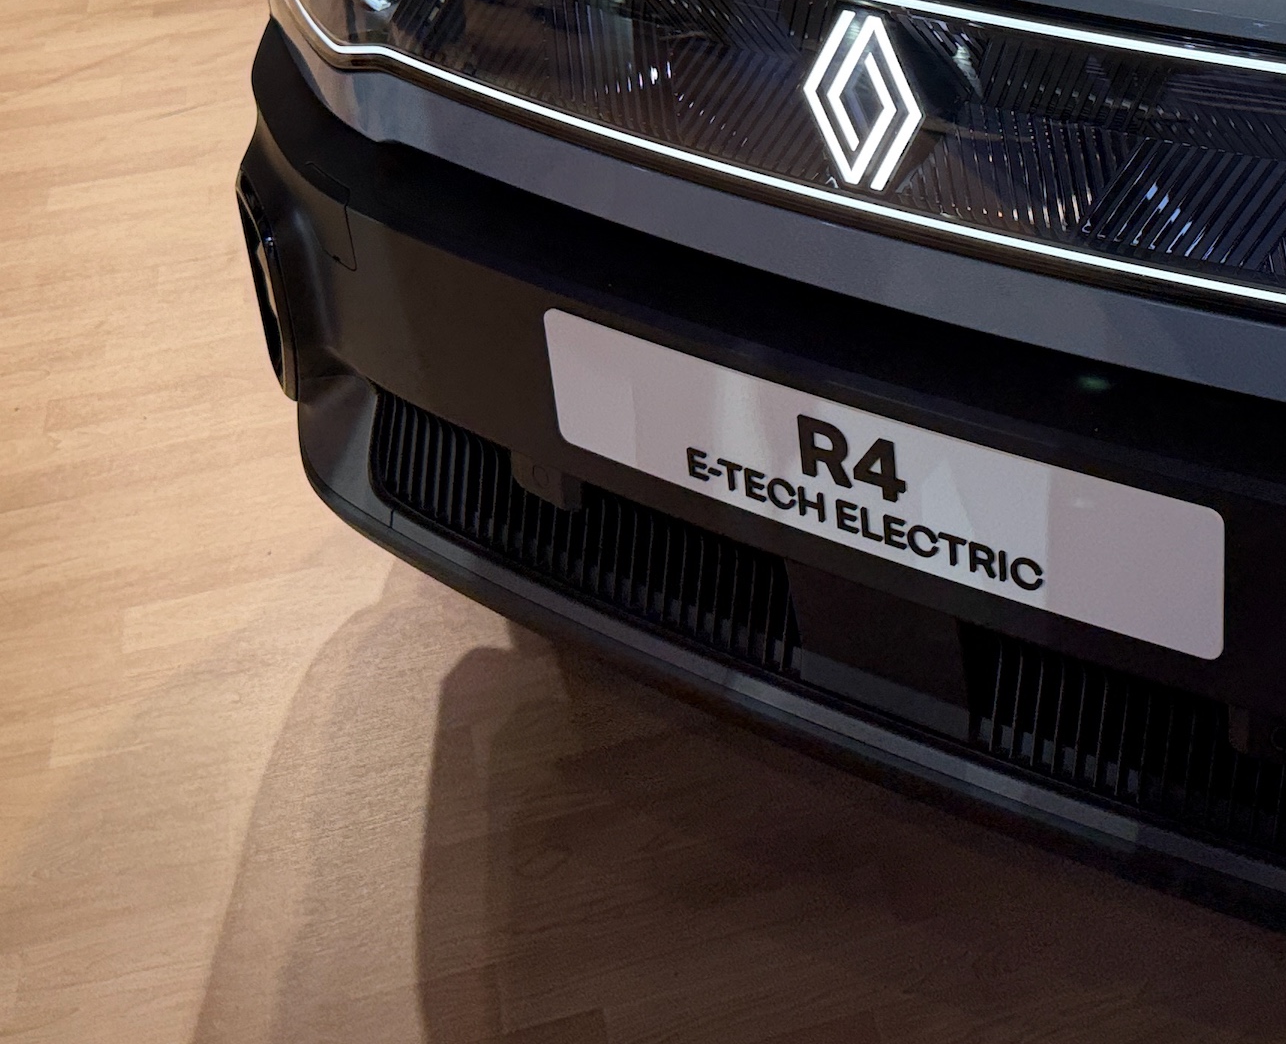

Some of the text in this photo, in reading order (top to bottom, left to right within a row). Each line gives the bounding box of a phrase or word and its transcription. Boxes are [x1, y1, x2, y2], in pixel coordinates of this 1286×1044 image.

[797, 414, 906, 503] R4
[686, 447, 1043, 591] E-TECH ELECTRIC
